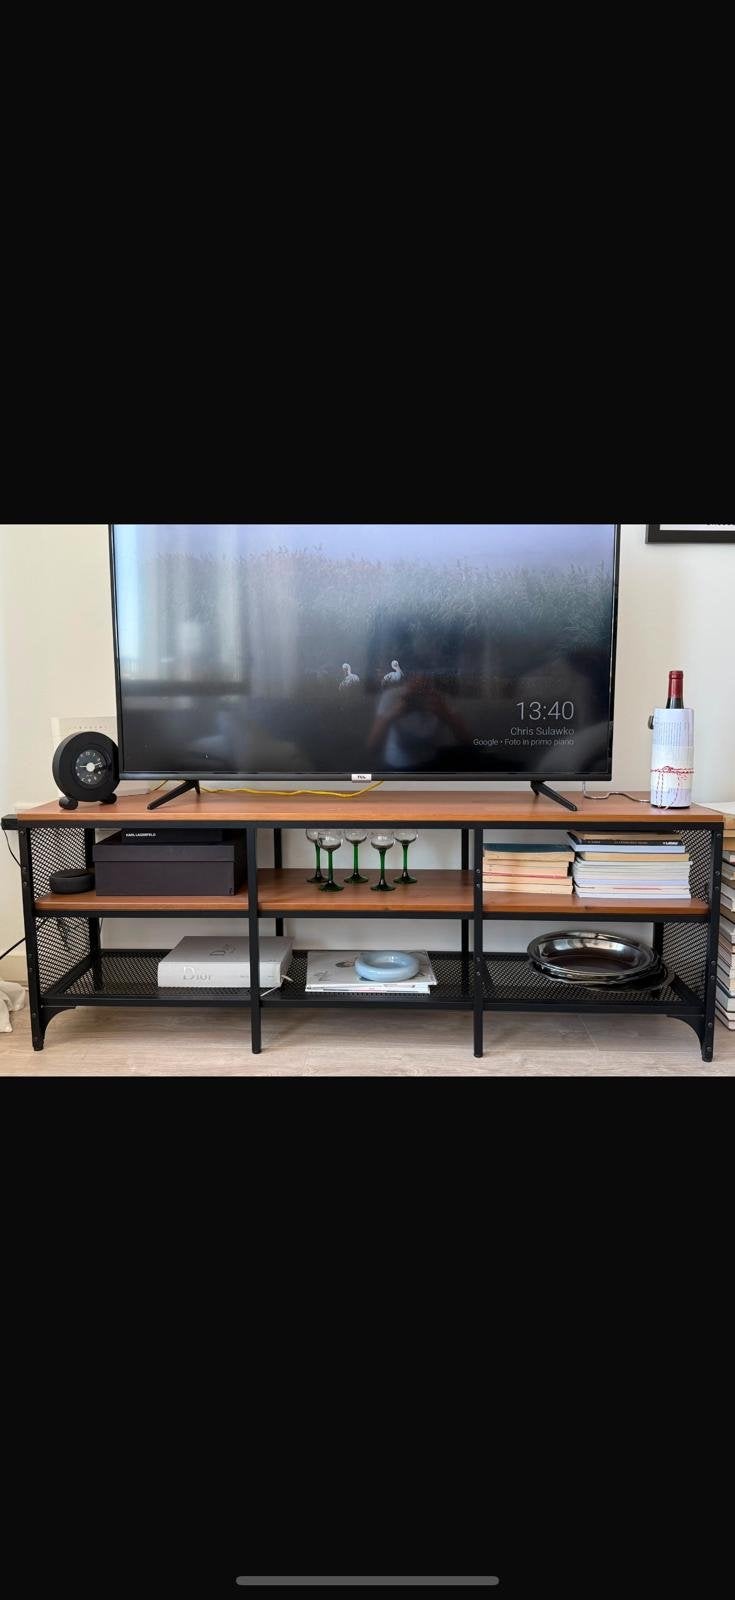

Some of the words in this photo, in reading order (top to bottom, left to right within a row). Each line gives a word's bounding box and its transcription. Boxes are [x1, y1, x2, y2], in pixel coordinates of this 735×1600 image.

[516, 701, 575, 720] 13:40
[510, 726, 534, 736] Chris
[535, 726, 575, 736] Sulawko
[472, 739, 499, 747] Google
[504, 738, 521, 746] Foto
[522, 738, 530, 746] in
[530, 738, 552, 747] primo
[553, 738, 575, 747] piano
